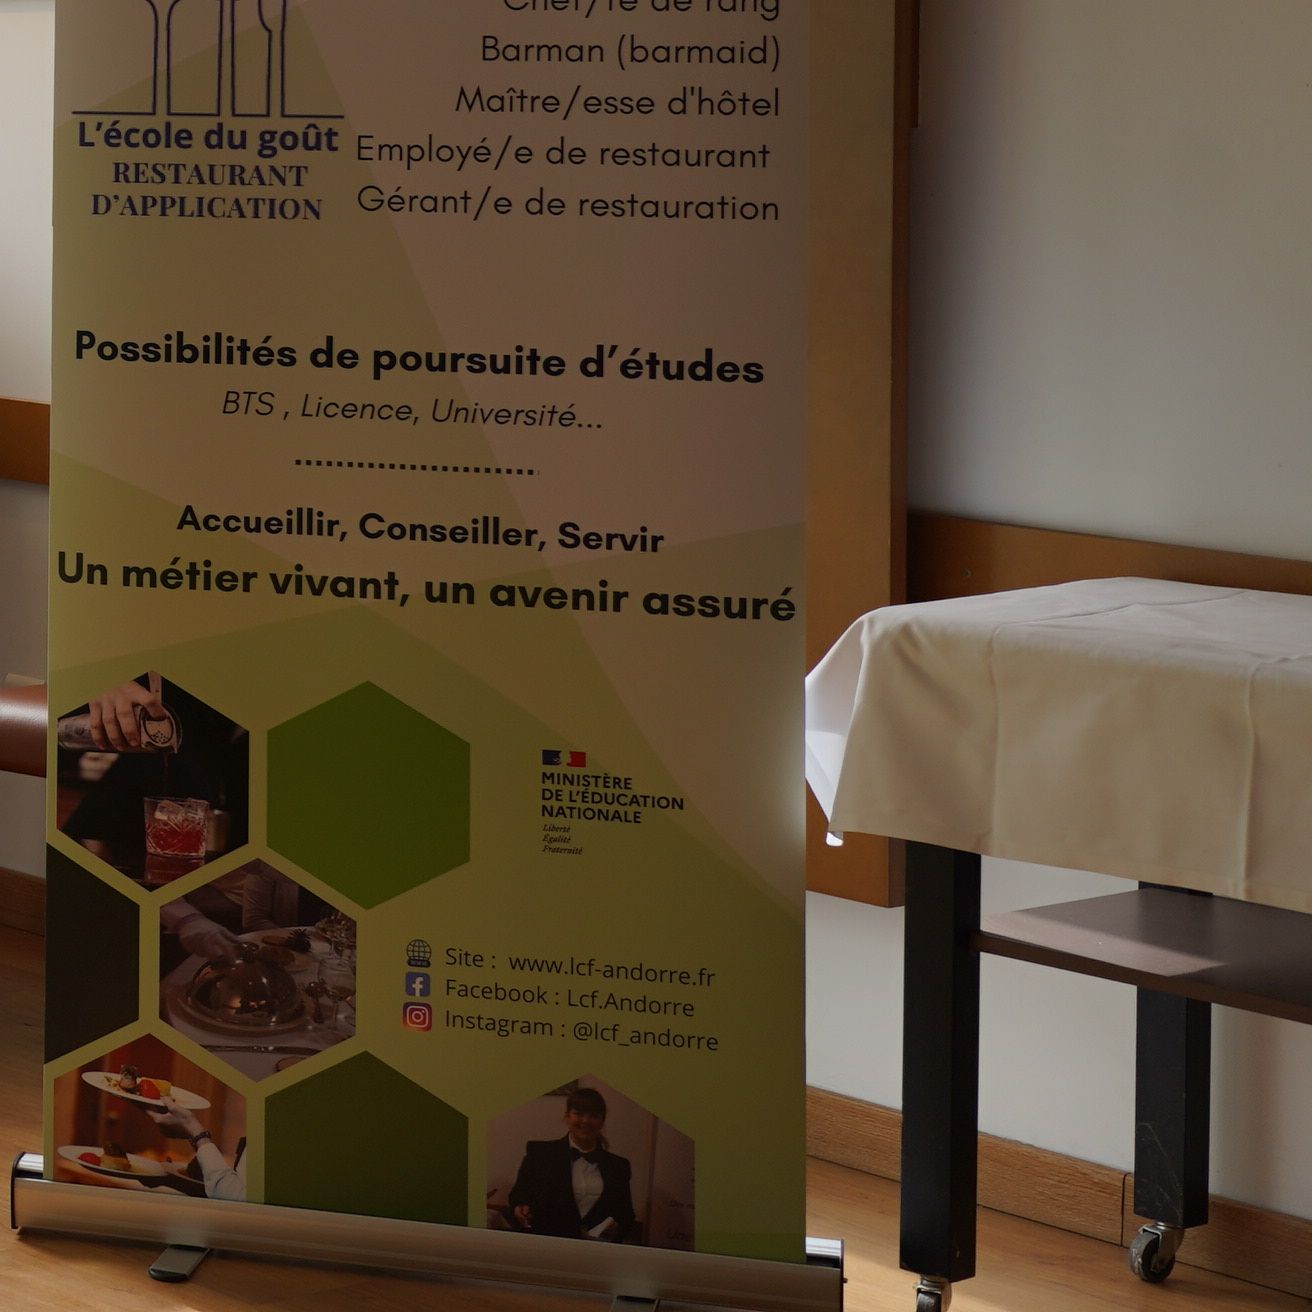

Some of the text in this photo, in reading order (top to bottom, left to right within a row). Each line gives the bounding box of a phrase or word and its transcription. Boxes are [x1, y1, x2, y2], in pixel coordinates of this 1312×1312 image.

[483, 34, 779, 72] Barman (barmaid)
[456, 85, 778, 120] Maître/esse d'hôtel
[79, 120, 338, 158] L'école du goût
[358, 134, 770, 171] Employé/e de restaurant
[112, 162, 308, 186] RESTAURANT
[92, 194, 322, 220] D'APPLICATION
[358, 186, 778, 221] Gérant/e de restauration
[76, 330, 763, 383] Possibilités de poursuite d'études
[223, 391, 275, 415] BTS
[301, 394, 419, 425] Licence,
[432, 399, 601, 428] Université...
[177, 505, 664, 552] Accueillir, Conseiller, Servir
[59, 551, 795, 621] Un métier vivant, un avenir assuré
[542, 772, 632, 789] MINISTÈRE
[542, 789, 684, 810] DE L'ÉDUCATION
[542, 805, 642, 823] NATIONALE
[445, 948, 484, 968] Site
[509, 956, 716, 987] www.lcf-andorre.fr
[445, 979, 547, 1005] Facebook
[568, 989, 695, 1017] Lcf.Andorre
[445, 1010, 553, 1036] Instagram
[573, 1021, 719, 1051] @lcf_andorre
